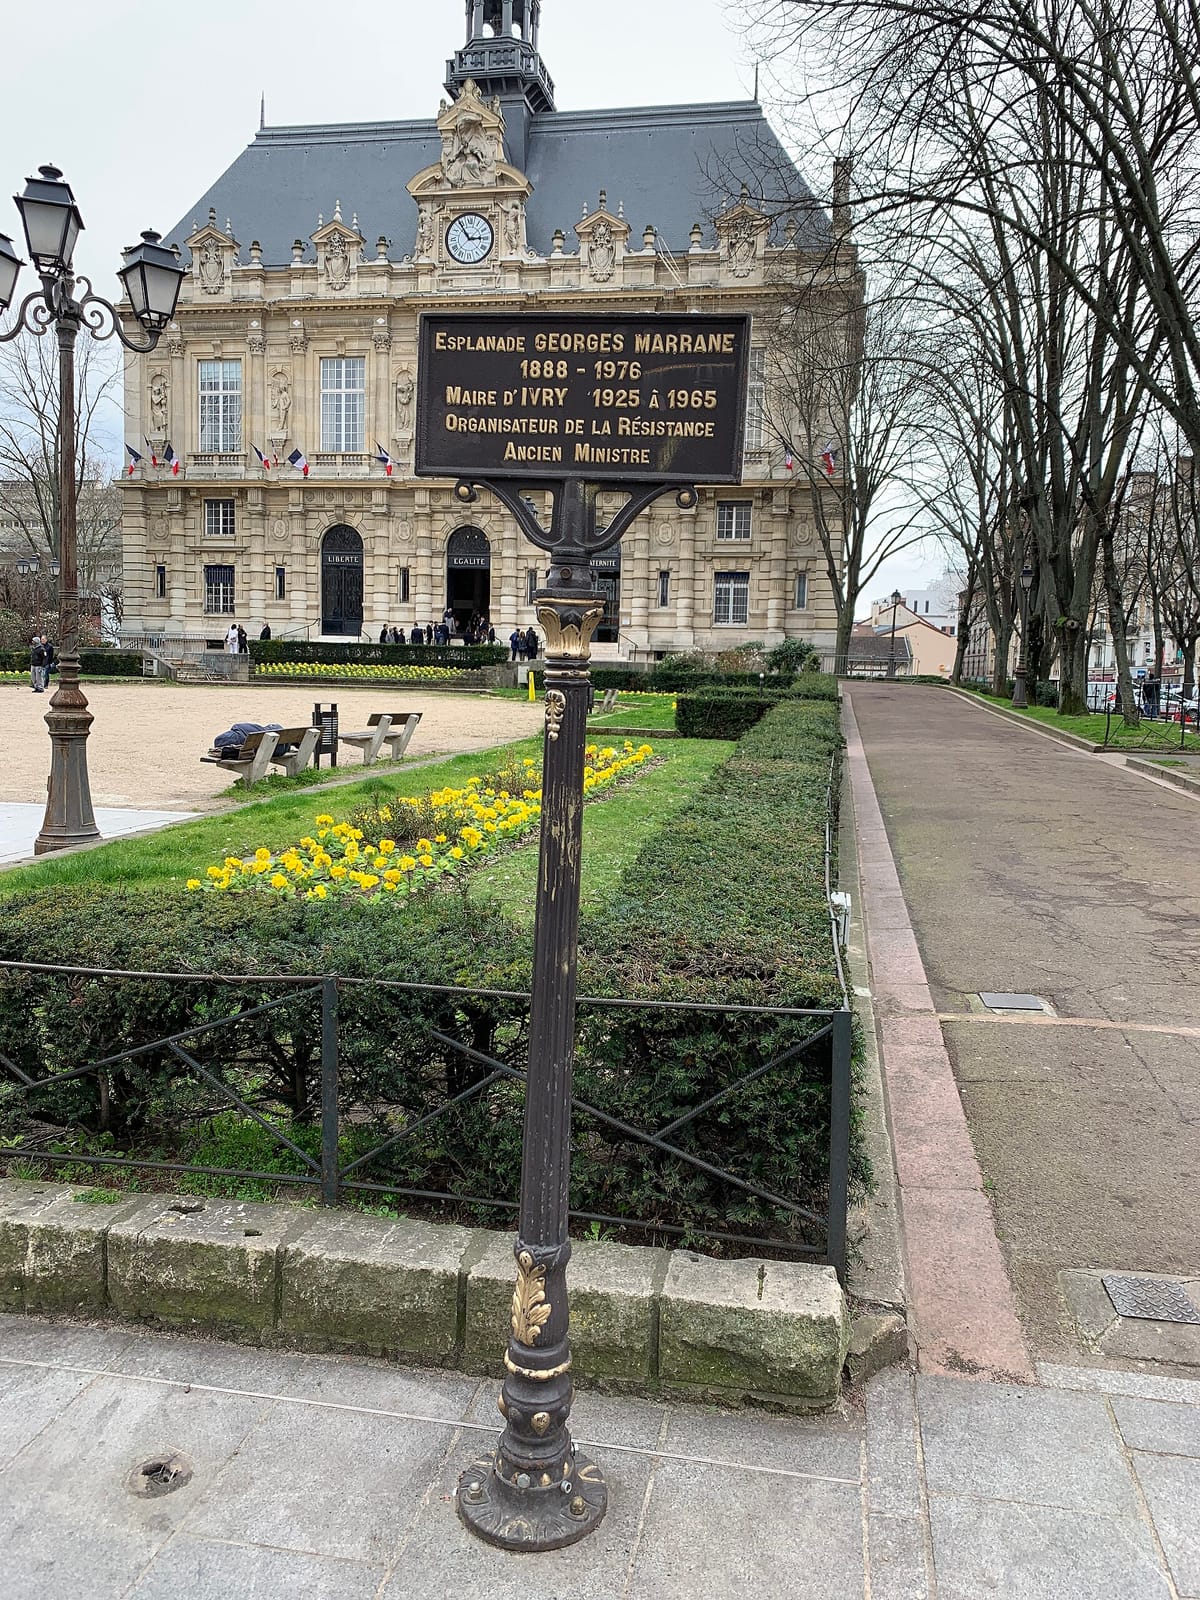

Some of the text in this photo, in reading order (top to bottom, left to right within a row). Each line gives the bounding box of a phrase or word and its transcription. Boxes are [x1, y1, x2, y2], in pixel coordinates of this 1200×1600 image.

[435, 332, 736, 355] ESPLANADE GEORGES MARRANE
[520, 359, 569, 380] 1888
[594, 360, 642, 381] 1976
[445, 385, 498, 406] MAIRE
[592, 388, 641, 409] 1925
[667, 389, 718, 409] 1965
[445, 413, 716, 438] ORGANISATEUR DE LA RÉSISTANCE
[503, 441, 651, 465] ANCIEN MINISTRE
